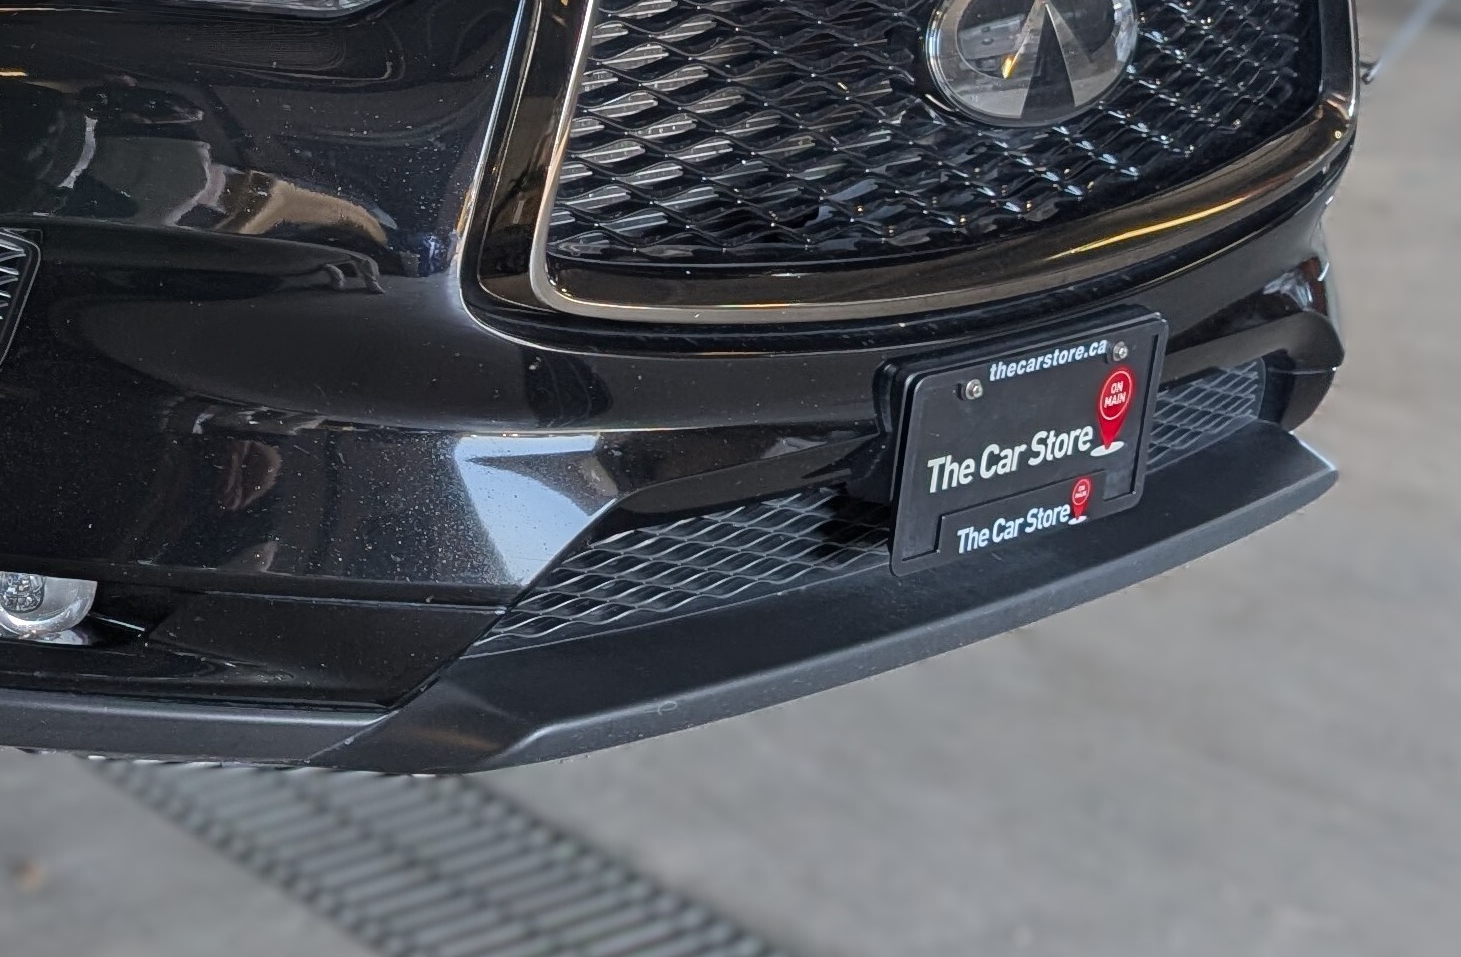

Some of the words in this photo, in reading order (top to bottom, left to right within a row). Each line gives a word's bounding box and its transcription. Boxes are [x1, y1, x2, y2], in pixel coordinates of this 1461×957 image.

[990, 340, 1107, 381] thecarstore.ca
[1104, 392, 1126, 408] MAIN
[1111, 381, 1124, 394] ON
[927, 454, 976, 494] The
[979, 443, 1028, 480] Car
[1027, 425, 1094, 466] Store
[956, 526, 990, 554] The
[992, 517, 1025, 544] Car
[1024, 503, 1071, 534] Store
